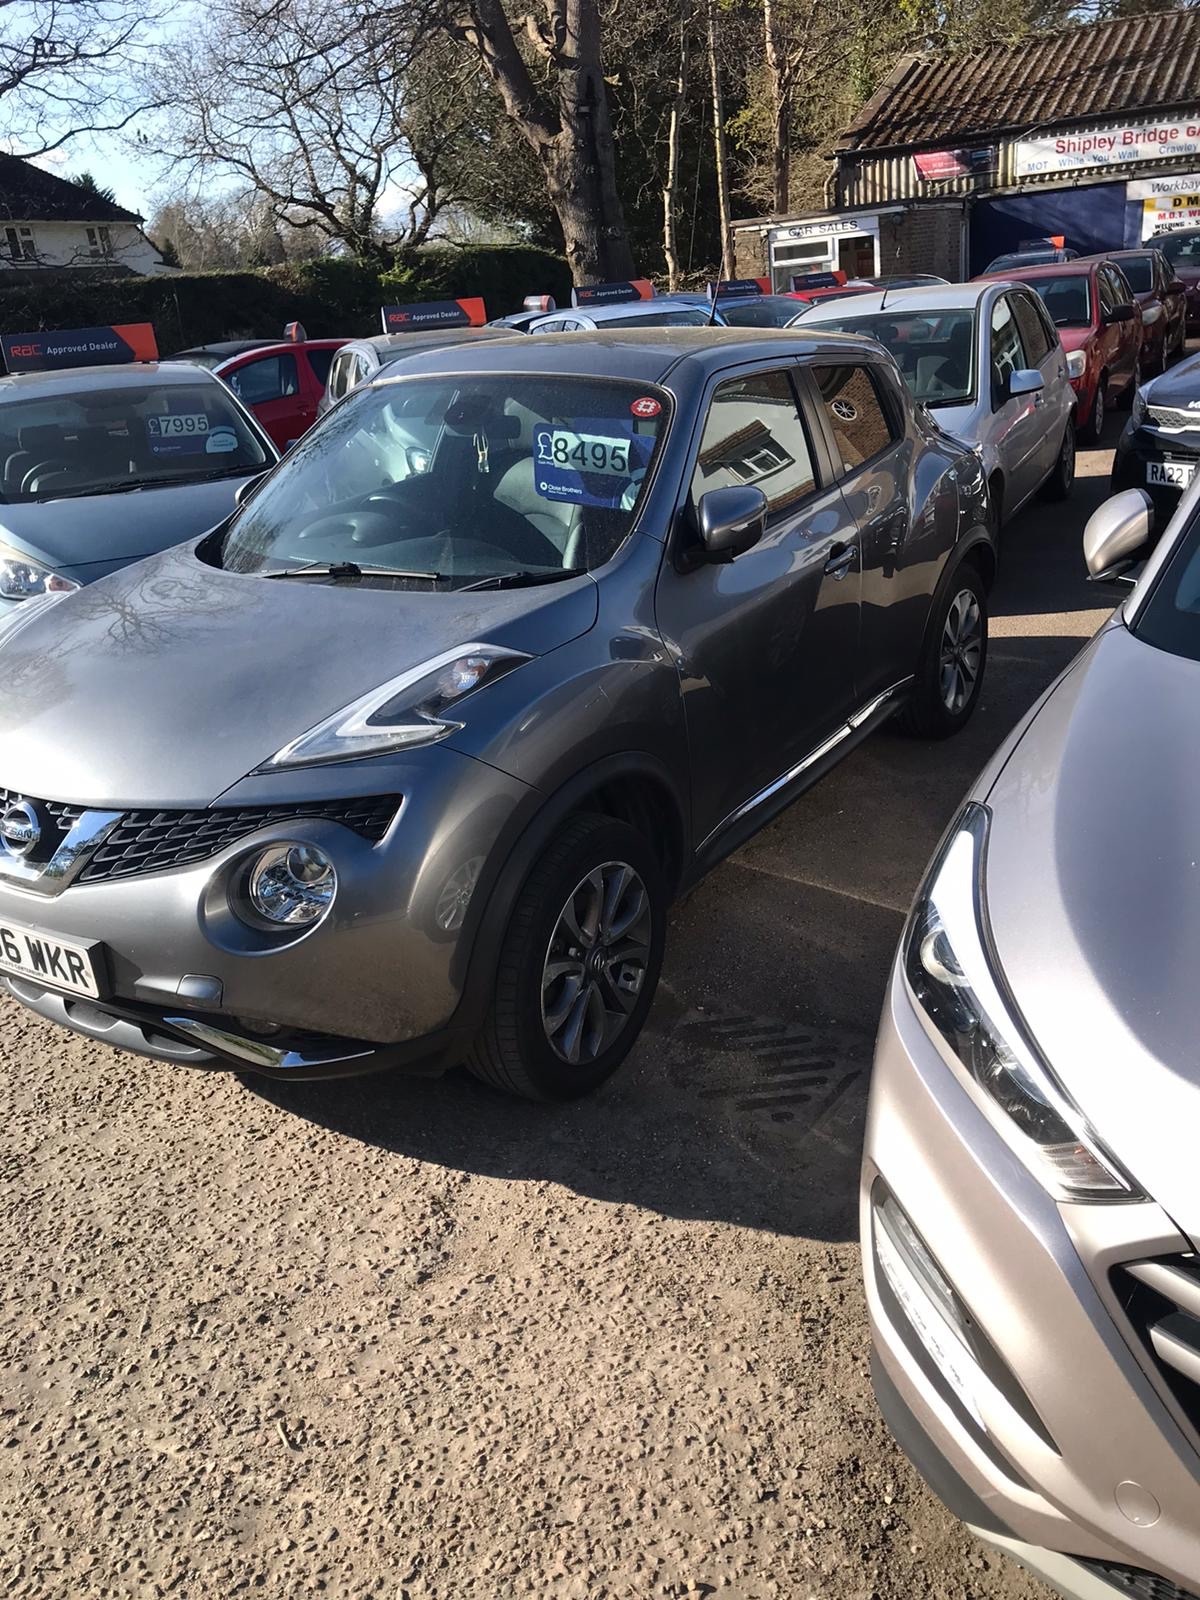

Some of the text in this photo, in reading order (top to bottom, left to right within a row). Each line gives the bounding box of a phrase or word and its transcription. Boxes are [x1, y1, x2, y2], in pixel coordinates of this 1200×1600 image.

[1055, 136, 1117, 154] Shipley
[1122, 127, 1179, 146] Bridge
[1027, 143, 1197, 172] MOT While You Wait Crawley
[788, 220, 858, 237] CAR SALES
[412, 313, 440, 321] Approved
[46, 343, 87, 355] Approved
[89, 341, 118, 351] Dealer
[1151, 465, 1184, 484] RA22
[562, 486, 582, 495] Brothers
[0, 928, 90, 989] 6 WKR
